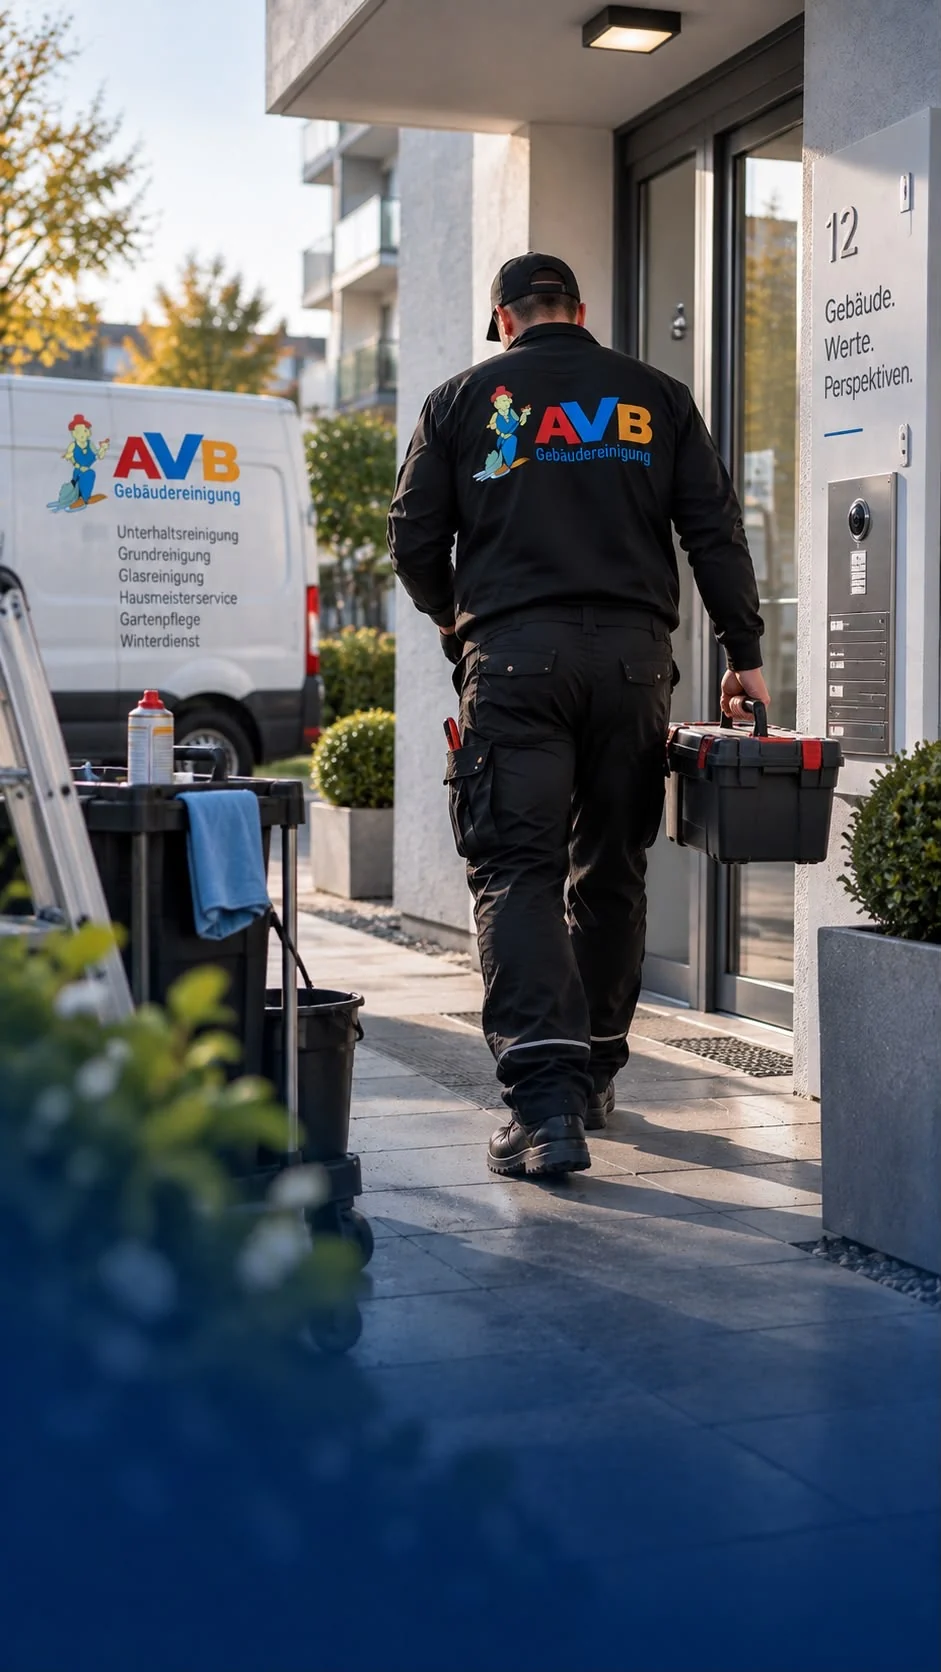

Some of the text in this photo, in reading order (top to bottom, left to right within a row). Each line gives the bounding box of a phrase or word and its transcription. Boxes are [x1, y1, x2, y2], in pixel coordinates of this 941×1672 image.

[826, 205, 858, 263] 12
[825, 285, 895, 324] Gebäude.
[824, 331, 874, 361] Werte.
[824, 363, 913, 400] Perspektiven.
[535, 397, 653, 445] AVB
[113, 432, 241, 483] AVB
[535, 443, 651, 467] Gebäudereinigung
[114, 483, 241, 506] Gebäudereinigung
[117, 524, 239, 545] Unterhaltsreinigung
[118, 567, 205, 587] Glasreinigung
[119, 590, 238, 605] Hausmeisterservice
[120, 611, 201, 630] Gartenpflege
[120, 633, 201, 648] Winterdienst
